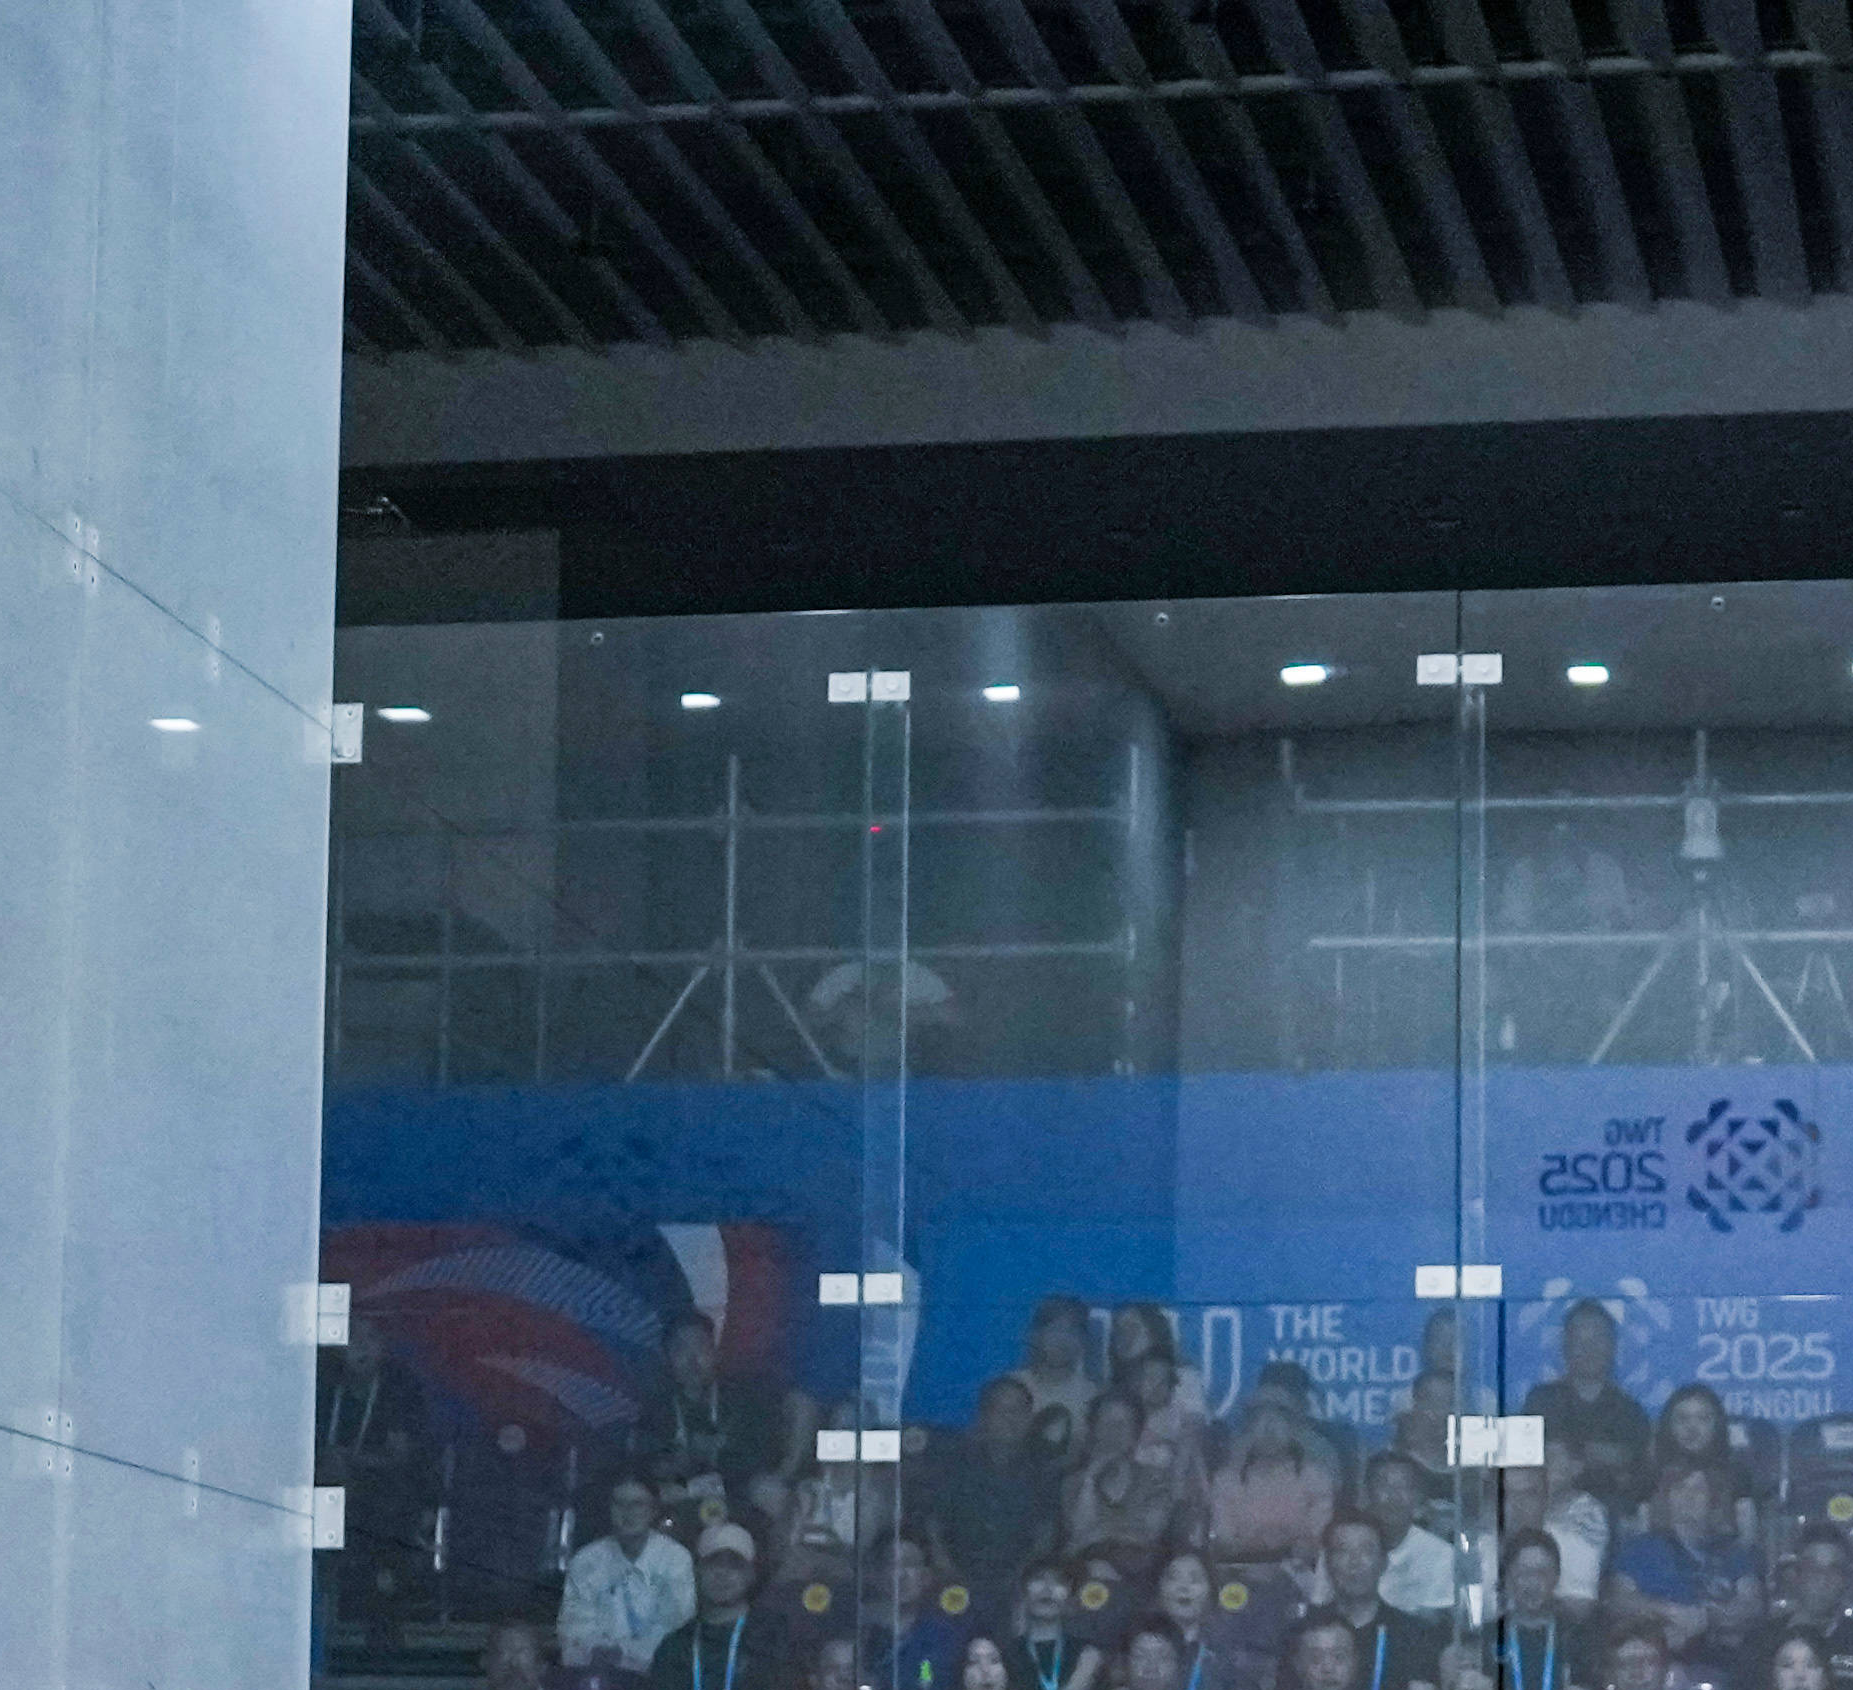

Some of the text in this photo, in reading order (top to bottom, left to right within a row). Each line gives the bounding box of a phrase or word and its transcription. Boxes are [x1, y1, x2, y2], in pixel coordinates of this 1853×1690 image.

[1269, 1303, 1346, 1341] THE
[1697, 1297, 1759, 1328] TWG
[1697, 1331, 1835, 1380] 2025
